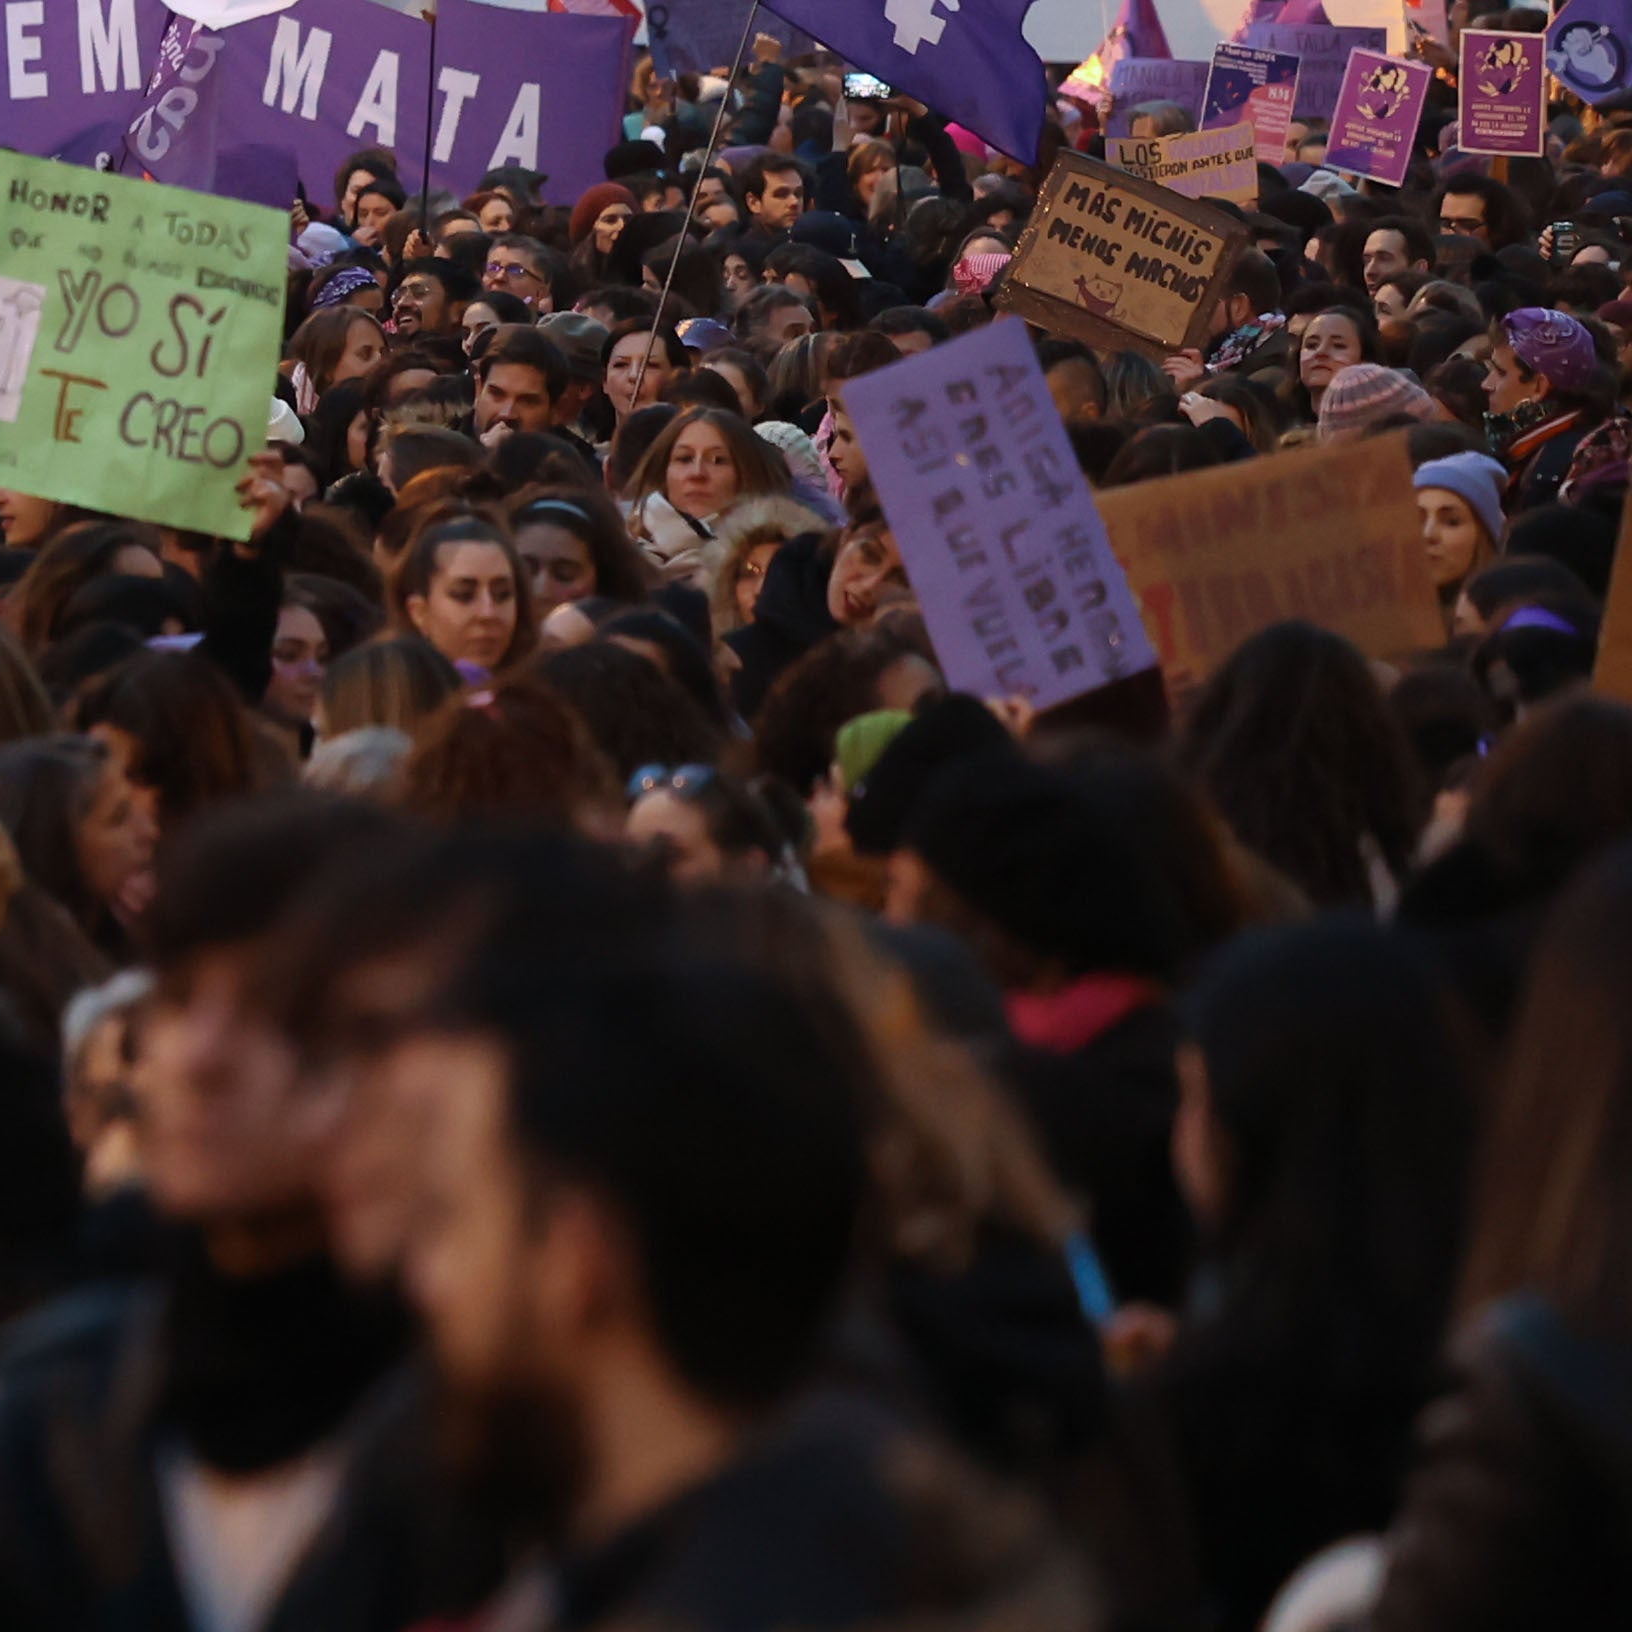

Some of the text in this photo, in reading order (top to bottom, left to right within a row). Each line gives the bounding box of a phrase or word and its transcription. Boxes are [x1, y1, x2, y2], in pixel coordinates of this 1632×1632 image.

[261, 16, 542, 171] MATA
[1119, 142, 1161, 166] LOS
[10, 179, 111, 223] HONOR
[166, 211, 254, 260] TODAS
[1064, 180, 1122, 225] MÁS
[1048, 217, 1122, 267] MENOS
[54, 270, 140, 354] YO
[119, 392, 244, 469] CREO
